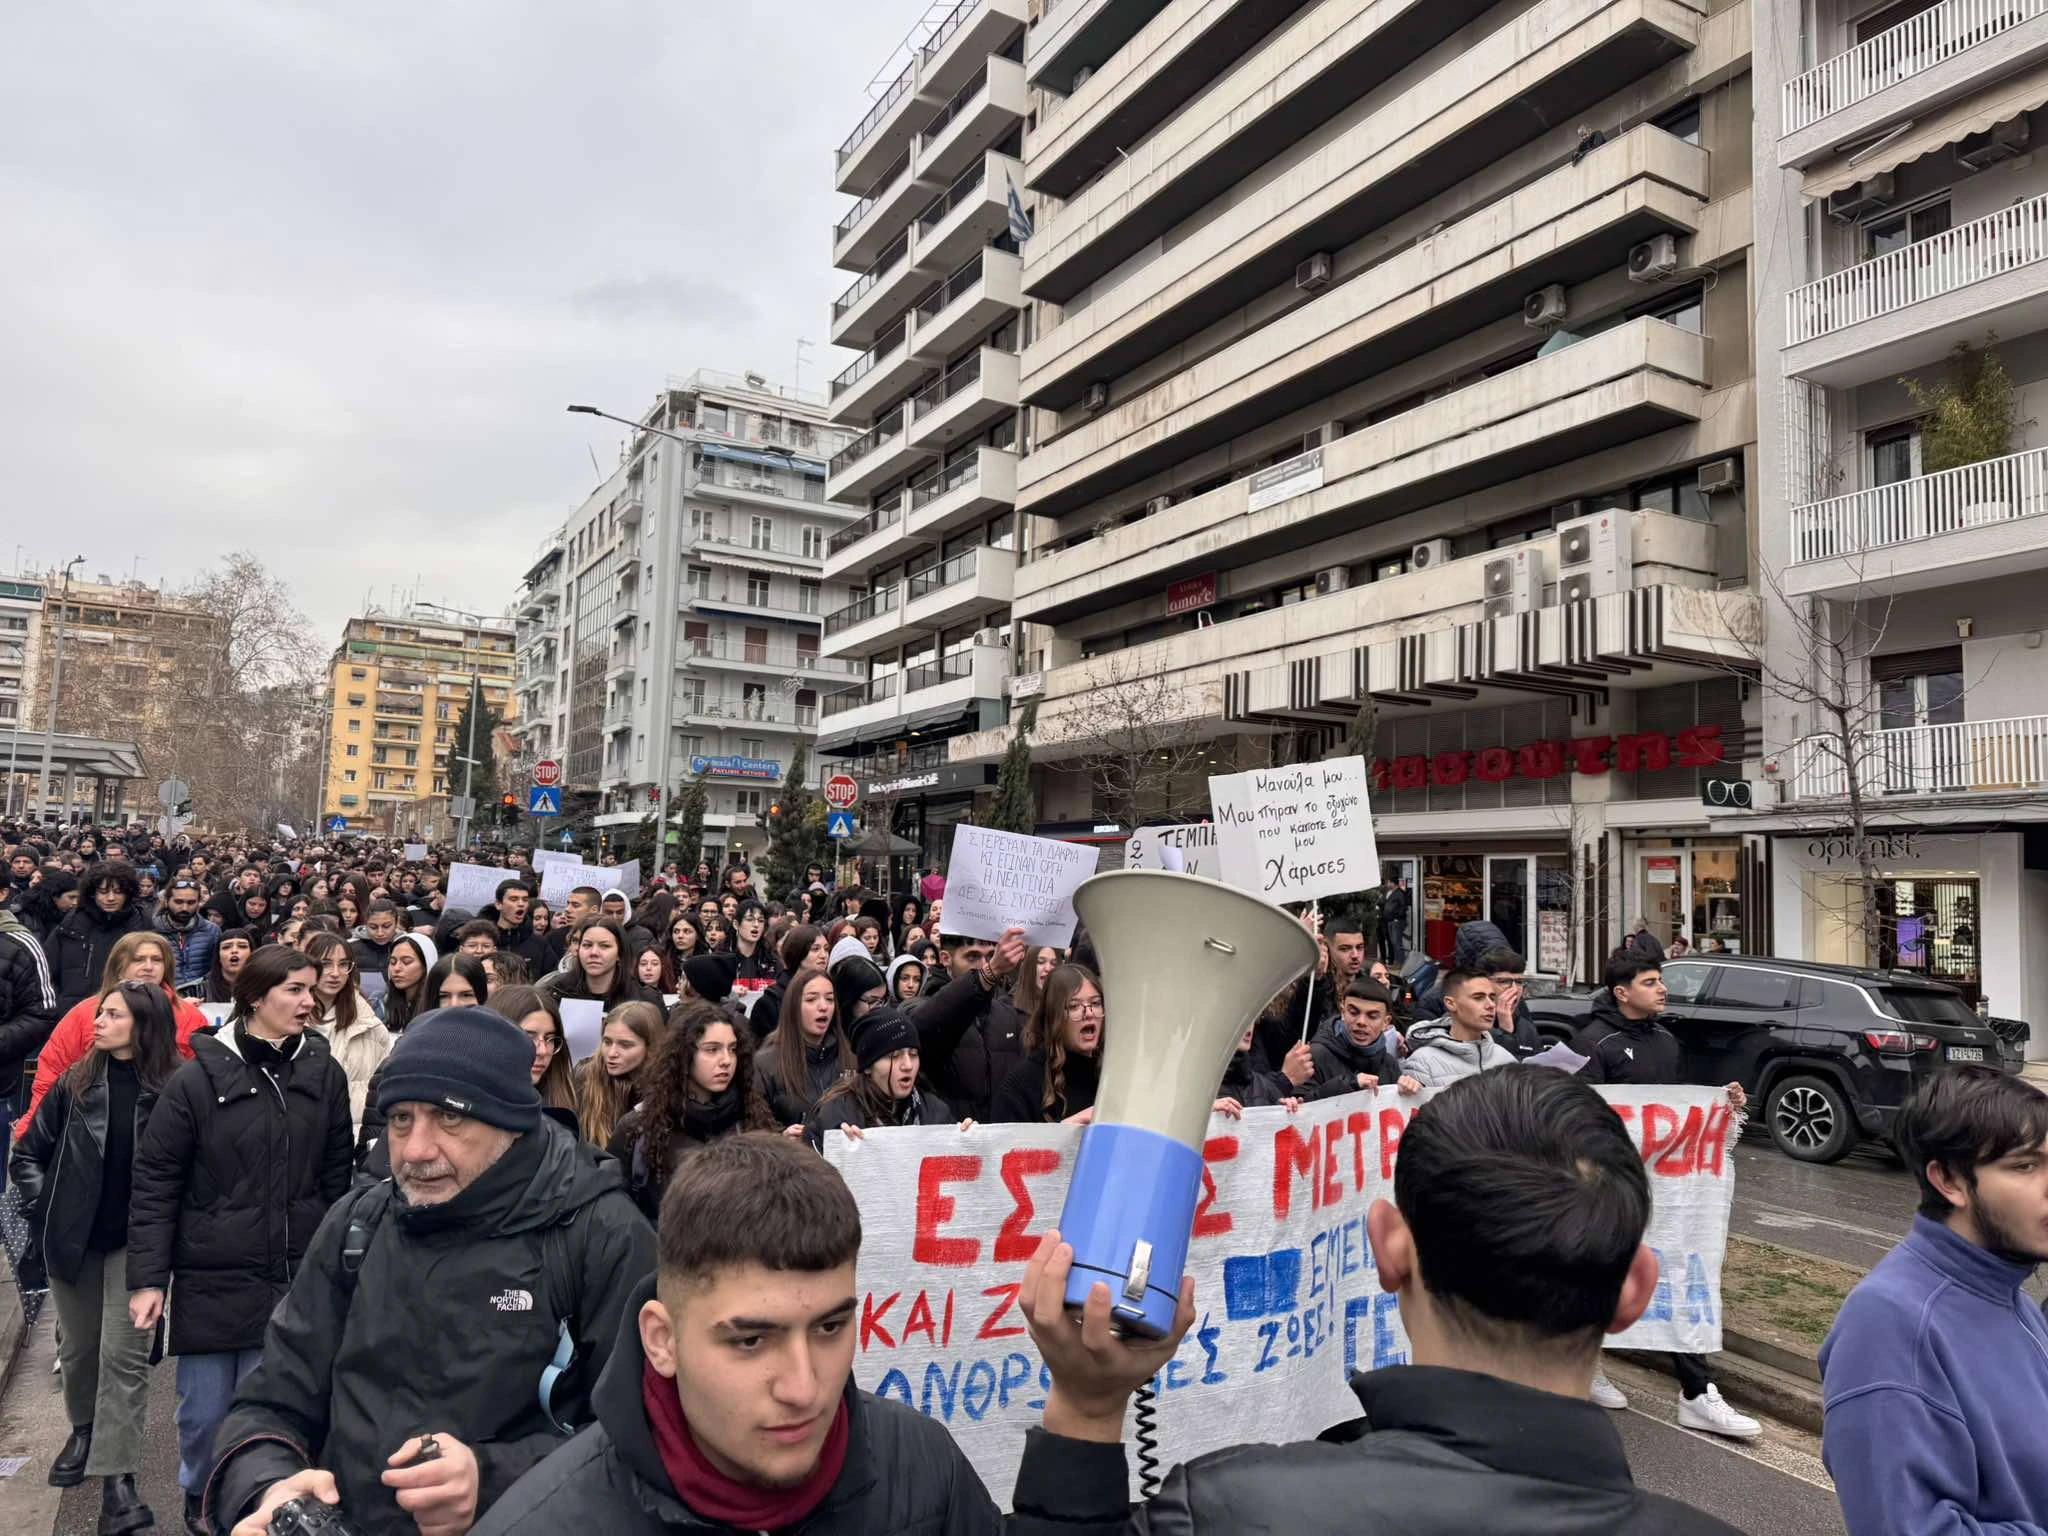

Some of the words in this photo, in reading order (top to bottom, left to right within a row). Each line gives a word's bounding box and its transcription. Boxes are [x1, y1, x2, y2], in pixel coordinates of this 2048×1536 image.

[535, 765, 558, 779] STOP
[828, 783, 855, 800] STOP
[1255, 772, 1315, 794] Μανούλα
[1218, 802, 1255, 827] Μου
[1257, 800, 1299, 822] πήραν
[1304, 801, 1318, 813] το
[1258, 826, 1281, 839] που
[1290, 819, 1328, 834] κάποτε
[1031, 841, 1044, 858] ΤΑ
[1294, 835, 1316, 852] μου
[1264, 854, 1346, 892] Χάρισες
[1272, 1108, 1420, 1222] ΜΕΤΡ
[489, 1295, 520, 1305] NORTH
[503, 1288, 520, 1298] THE
[497, 1303, 520, 1312] FACE
[859, 1287, 954, 1353] ΚΑΙ
[975, 1282, 1026, 1340] Ζ
